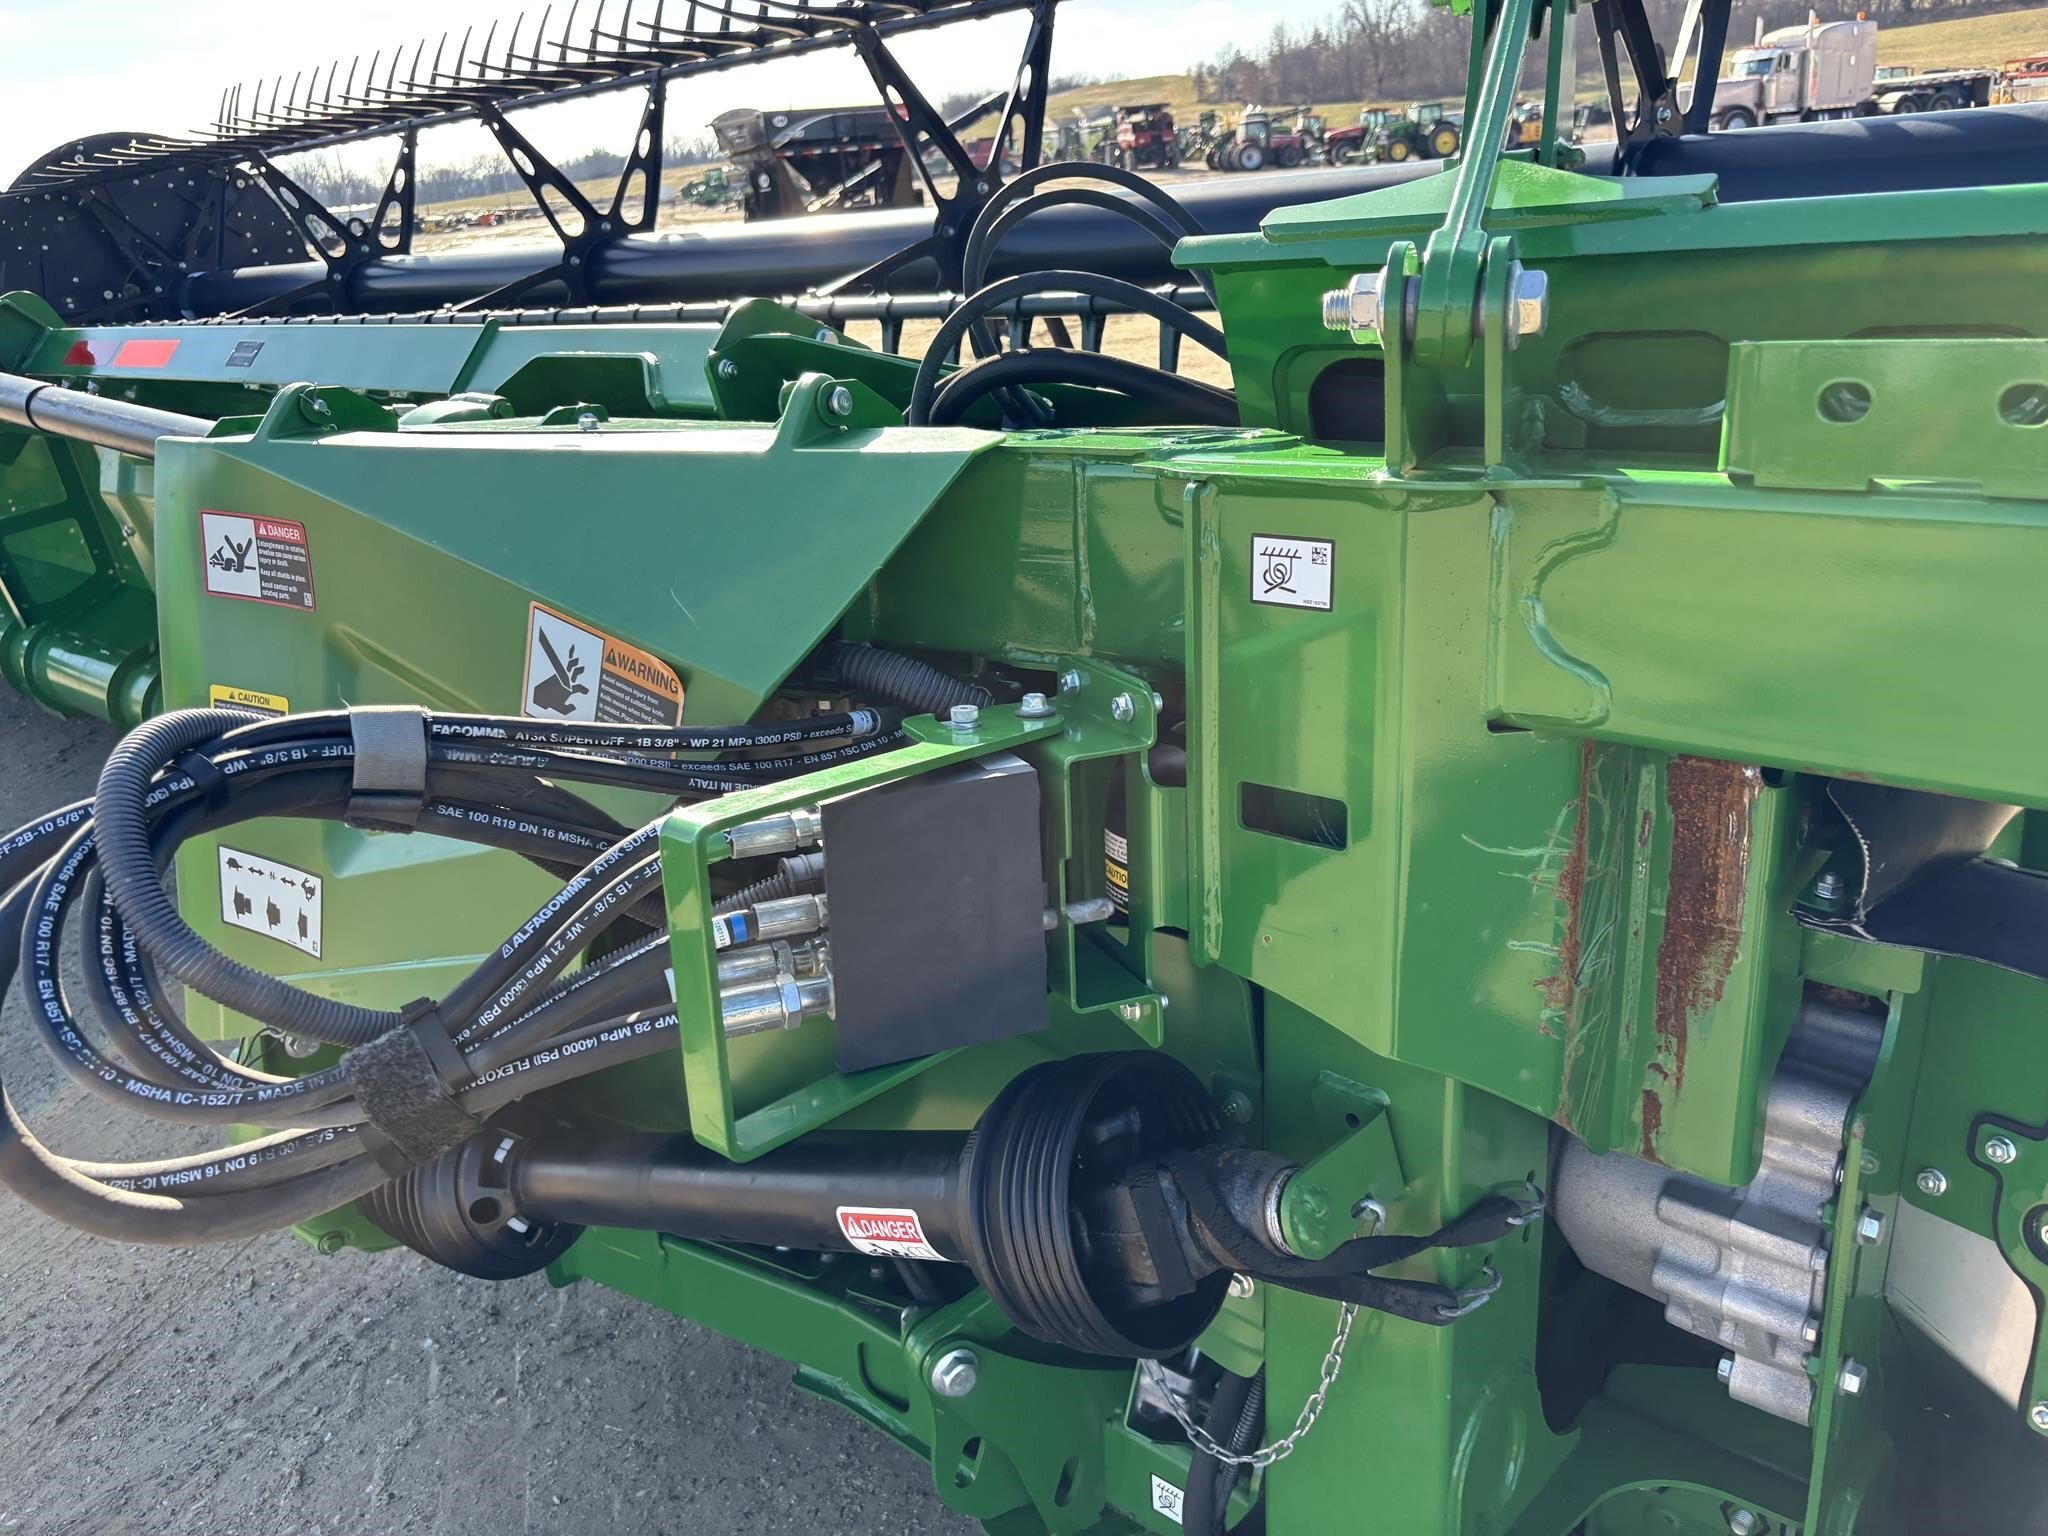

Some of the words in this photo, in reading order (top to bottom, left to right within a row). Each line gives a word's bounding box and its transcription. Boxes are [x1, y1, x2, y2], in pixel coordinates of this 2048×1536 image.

[267, 525, 300, 540] DANGER
[618, 652, 679, 694] WARNING
[238, 692, 270, 706] CAUTION
[616, 681, 633, 692] serious
[633, 689, 647, 700] injury
[432, 724, 509, 739] FAGOMMA
[636, 738, 652, 747] 1B
[690, 738, 710, 747] WP
[712, 738, 724, 747] 21
[728, 737, 752, 747] MPa
[755, 735, 781, 746] (3000
[784, 732, 802, 744] PSI)
[809, 727, 845, 740] exceeds
[291, 748, 308, 759] 1B
[321, 745, 356, 757] TUFF
[681, 762, 726, 771] exceeds
[729, 762, 751, 771] SAE
[754, 760, 772, 770] 100
[774, 759, 794, 769] R17
[803, 754, 819, 765] EN
[820, 751, 838, 761] 857
[840, 745, 860, 757] 1SC
[861, 740, 877, 750] DN
[877, 736, 889, 745] 10
[223, 761, 248, 775] WP
[688, 778, 718, 791] ITALY
[720, 782, 733, 791] IN
[735, 782, 761, 793] ADE
[56, 809, 85, 827] 5/8"
[437, 804, 464, 818] SAE
[467, 811, 489, 824] 100
[492, 816, 516, 829] R19
[519, 822, 539, 835] DN
[541, 828, 556, 839] 16
[558, 831, 593, 847] MSHA
[45, 882, 67, 912] SAE
[512, 876, 592, 949] ALFAGOMMA
[593, 847, 624, 875] AT3K
[623, 827, 660, 852] SUPE
[616, 880, 633, 896] 1B
[38, 916, 54, 937] 100
[101, 917, 113, 931] 10
[36, 941, 50, 966] R17
[101, 935, 114, 955] DN
[550, 940, 566, 956] 21
[104, 957, 119, 981] 1SC
[526, 955, 553, 979] MPa
[38, 980, 54, 1000] EN
[111, 986, 128, 1006] 857
[500, 979, 529, 1008] (3000
[45, 1001, 65, 1023] 857
[121, 1008, 139, 1024] EN
[479, 1004, 501, 1027] PSI)
[655, 1014, 679, 1029] WP
[601, 1028, 632, 1041] MPa
[635, 1021, 651, 1034] 28
[140, 1033, 161, 1052] R17
[160, 1030, 198, 1063] MSHA
[563, 1036, 598, 1056] (4000
[161, 1052, 181, 1069] 100
[534, 1047, 560, 1067] PSI)
[181, 1065, 210, 1083] SAE
[203, 1064, 219, 1078] 10
[220, 1072, 241, 1087] DN
[125, 1080, 172, 1103] MSHA
[175, 1092, 244, 1106] IC-152/7
[258, 1082, 305, 1102] MADE
[205, 1165, 221, 1178] 16
[225, 1158, 246, 1173] DN
[160, 1168, 202, 1187] MSHA
[860, 1220, 919, 1239] DANGER
